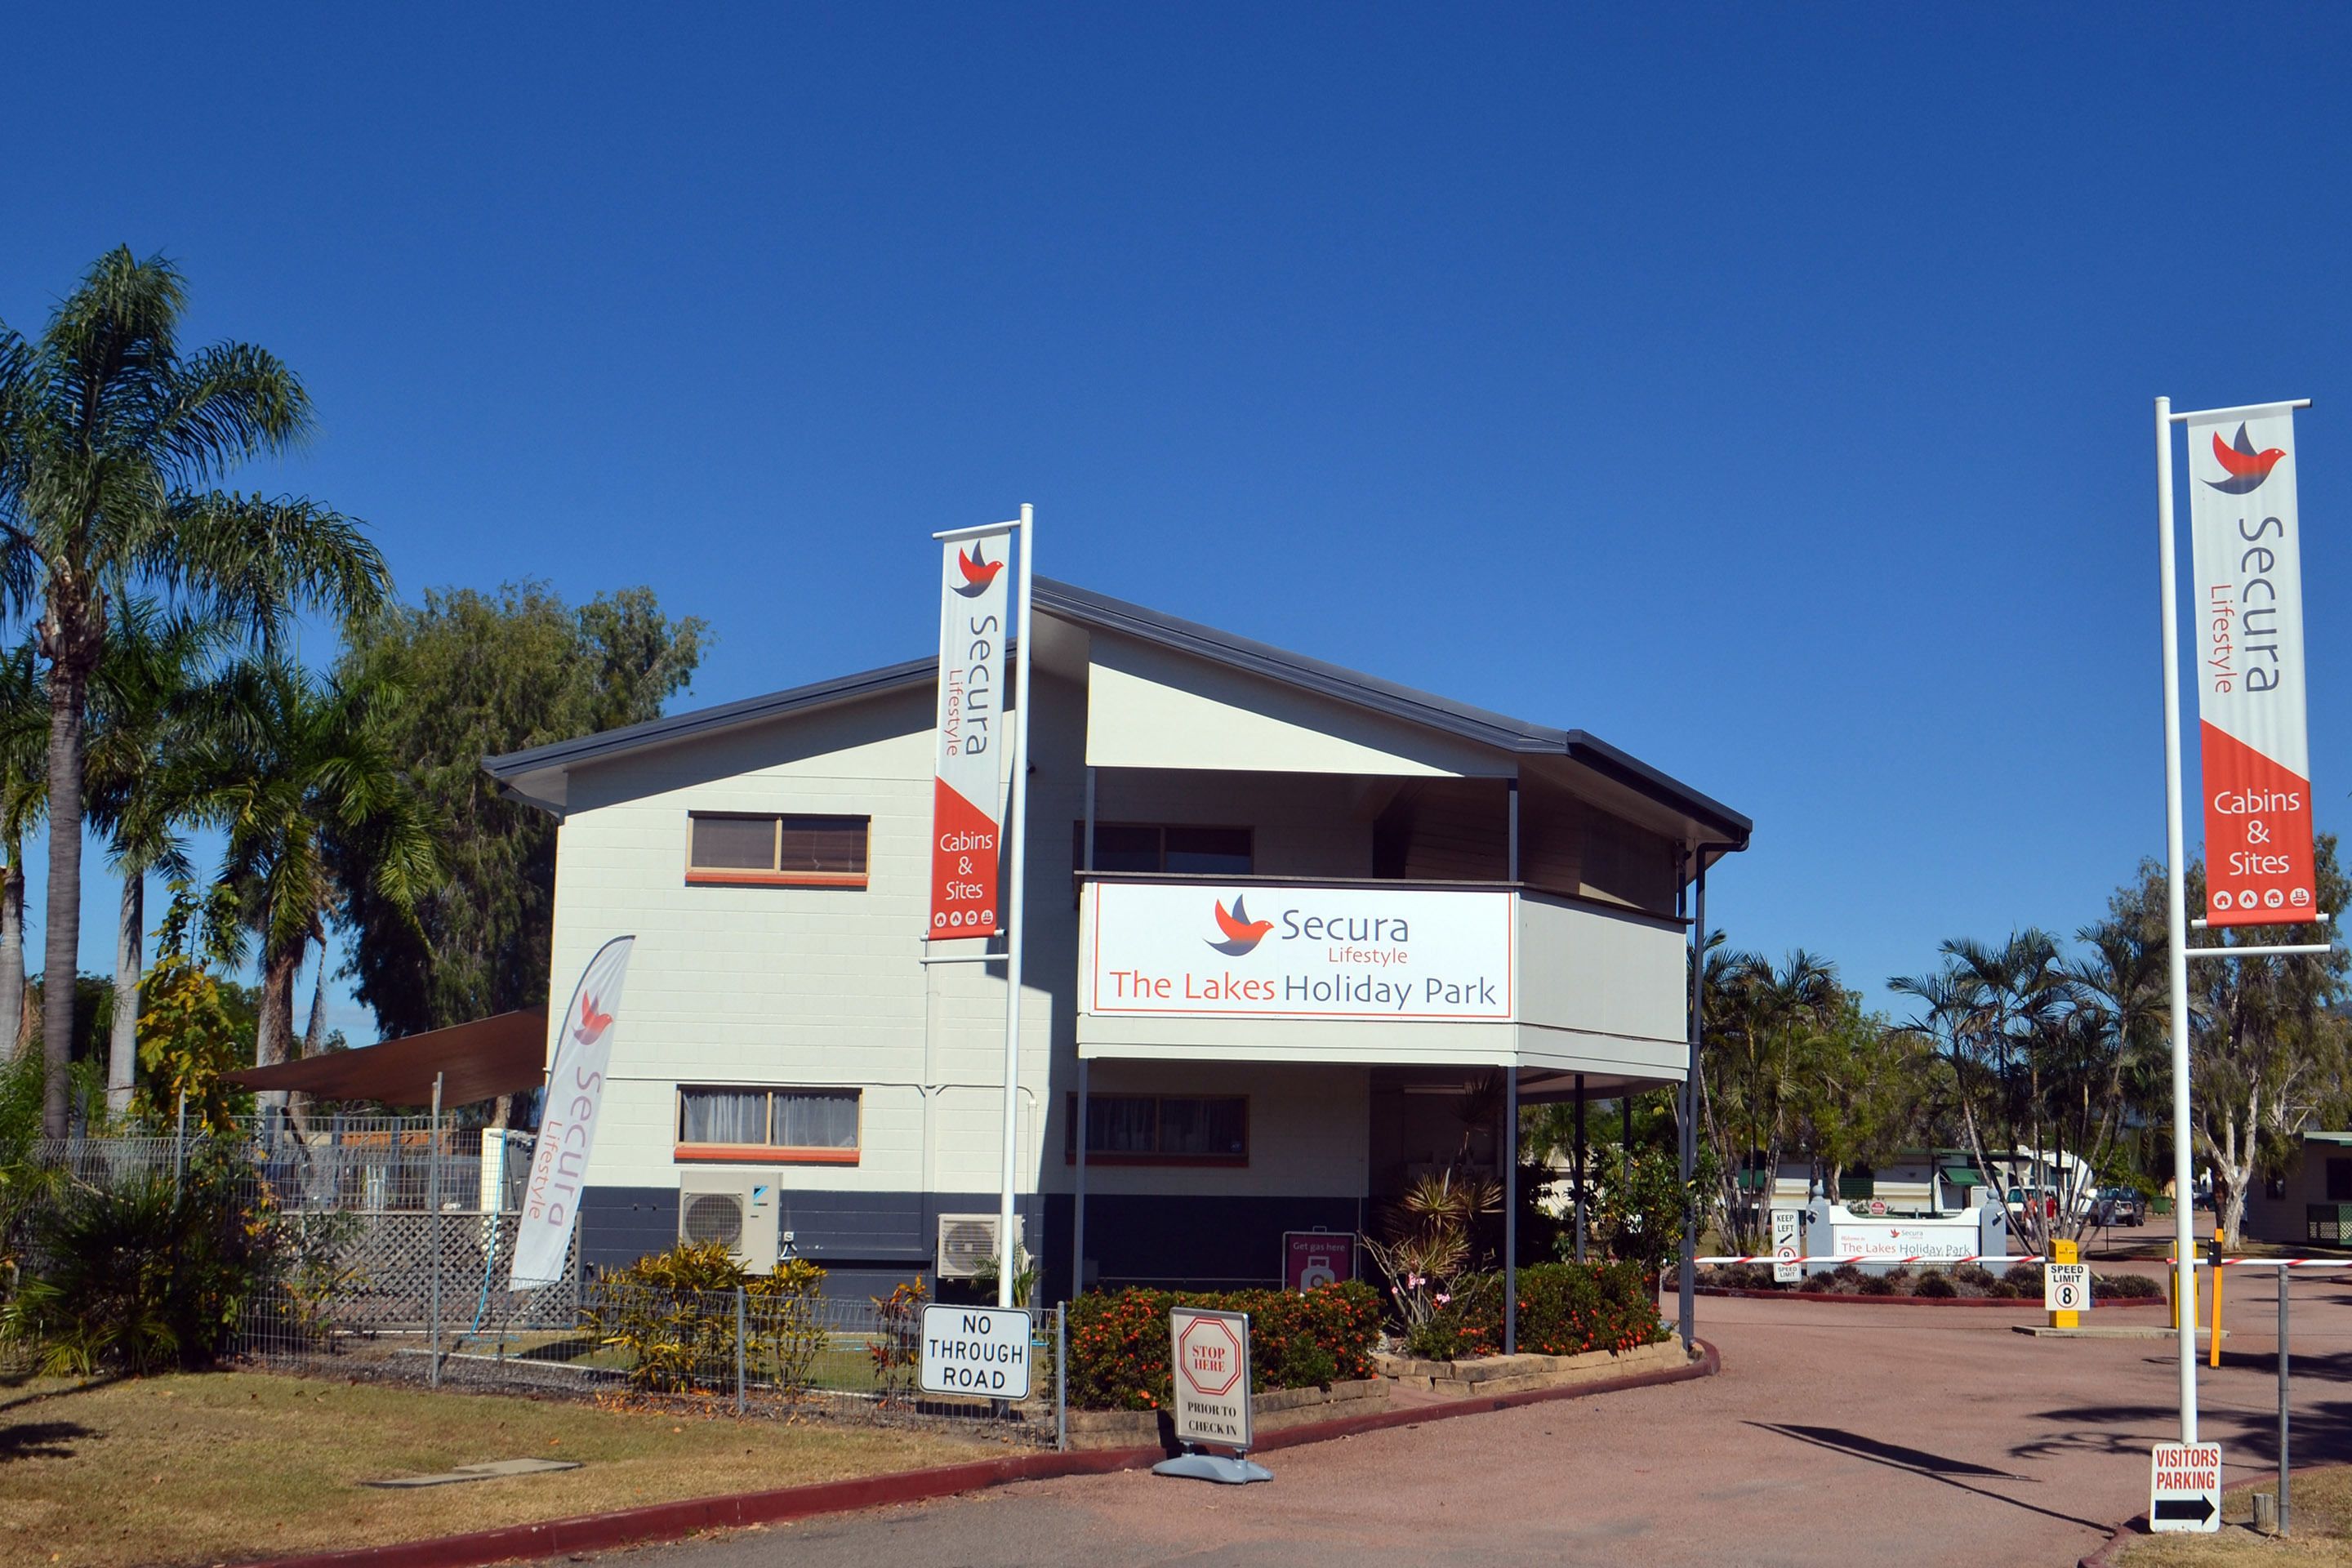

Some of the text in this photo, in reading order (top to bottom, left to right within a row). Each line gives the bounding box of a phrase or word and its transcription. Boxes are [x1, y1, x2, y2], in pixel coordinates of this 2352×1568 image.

[2238, 515, 2284, 693] Secura
[2208, 584, 2238, 694] Lifestyle
[965, 615, 998, 755] Secura
[944, 669, 964, 756] Lifestyle
[2214, 788, 2301, 814] Cabins
[2247, 819, 2270, 843] &
[940, 831, 993, 853] Cabins
[957, 856, 973, 875] &
[2229, 852, 2289, 876] Sites
[946, 881, 983, 902] Sites
[1281, 909, 1410, 942] Secura
[1329, 946, 1408, 968] Lifestyle
[1109, 969, 1497, 1011] The Lakes Holiday Park
[548, 1066, 601, 1227] Secura
[529, 1120, 563, 1220] Lifestyle
[1777, 1224, 1794, 1232] LEFT
[1293, 1242, 1346, 1253] Get gas here
[1842, 1242, 1971, 1256] The Lakes Holiday Park
[2051, 1265, 2083, 1274] SPEED
[2053, 1275, 2081, 1283] LIMIT
[2062, 1287, 2072, 1304] 8
[963, 1315, 992, 1334] NO
[929, 1339, 1022, 1364] THROUGH
[1192, 1345, 1225, 1360] STOP
[1194, 1358, 1225, 1372] HERE
[943, 1366, 1005, 1389] ROAD
[1187, 1401, 1236, 1418] PRIOR TO
[1188, 1420, 1237, 1436] CHECK IN
[2156, 1449, 2218, 1468] VISITORS
[2156, 1471, 2215, 1490] PARKING
